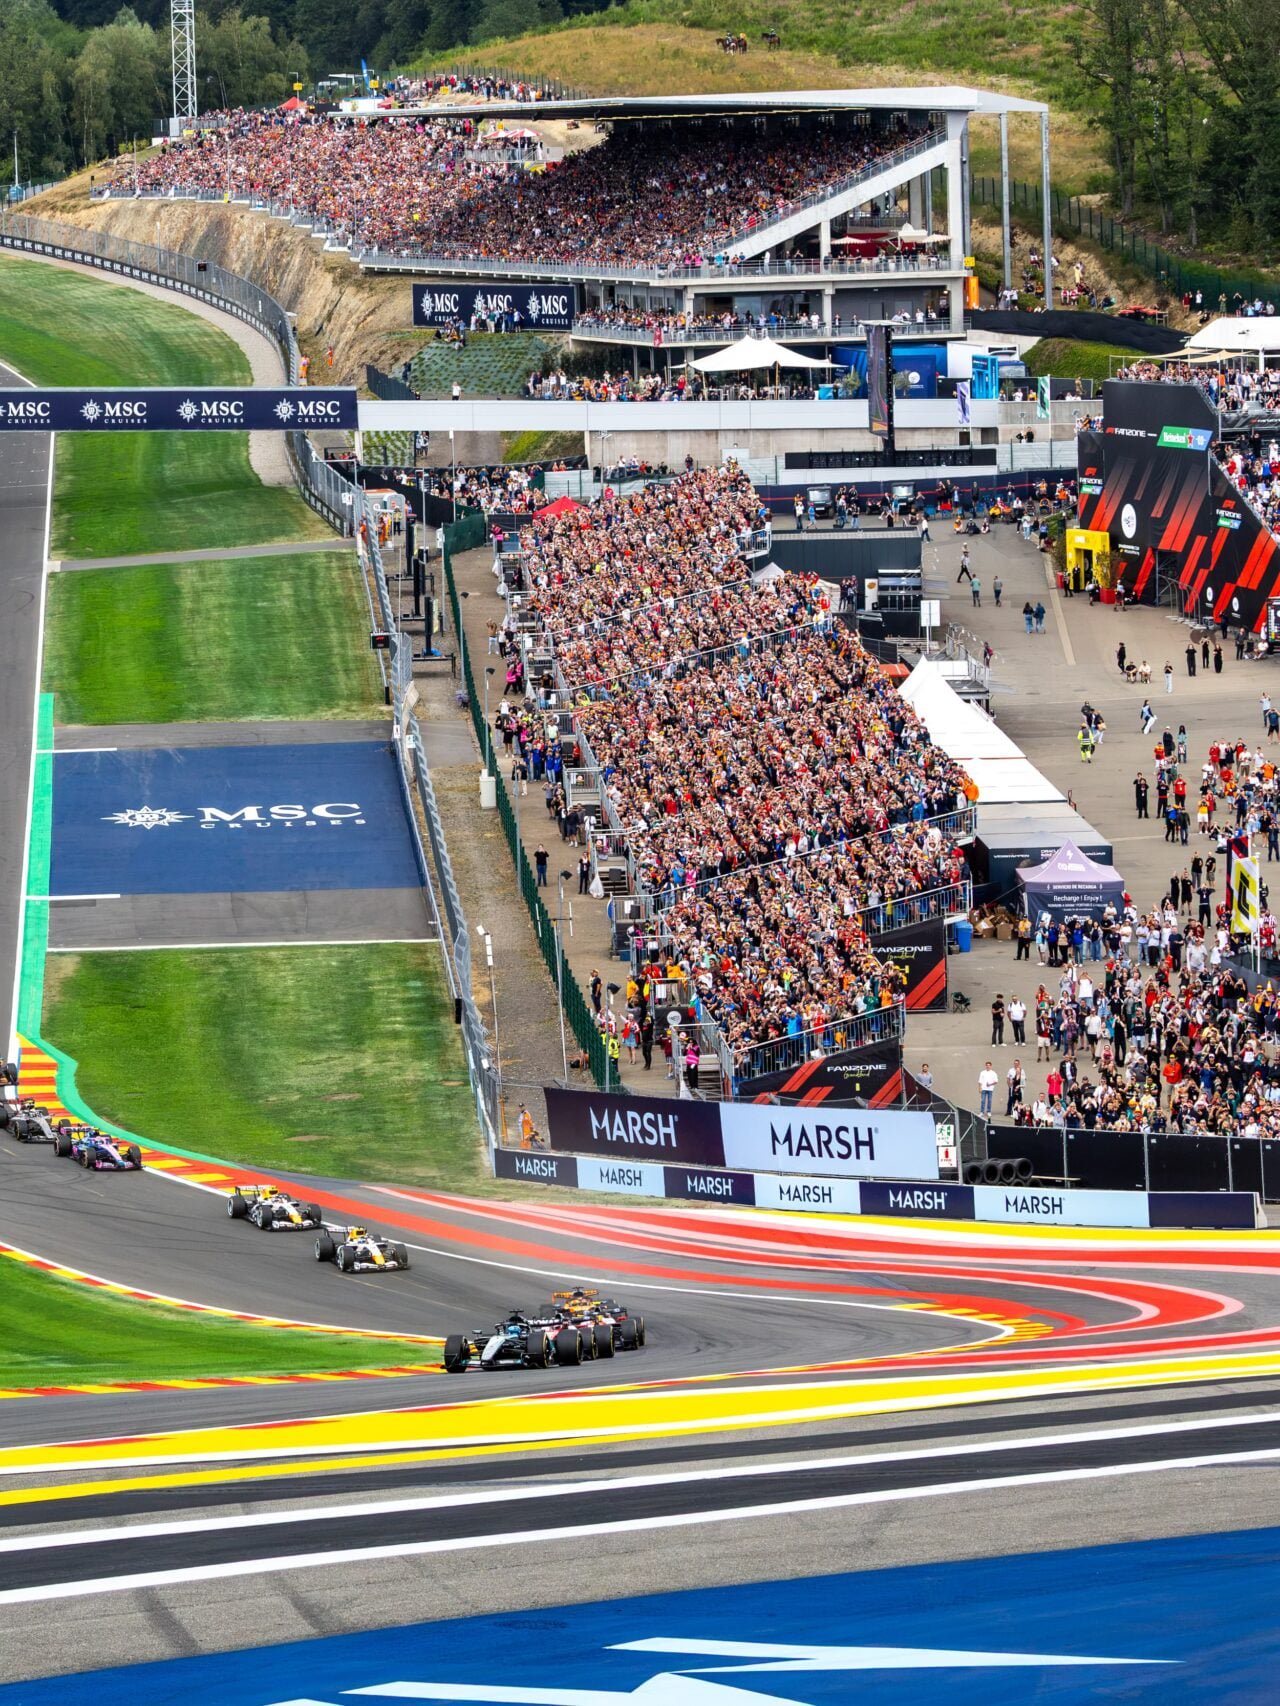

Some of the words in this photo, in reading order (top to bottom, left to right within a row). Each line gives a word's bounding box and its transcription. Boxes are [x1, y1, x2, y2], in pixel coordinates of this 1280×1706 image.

[434, 294, 459, 312] MSC
[486, 294, 512, 314] MSC
[541, 295, 568, 315] MSC
[8, 402, 50, 417] MSC
[104, 402, 147, 417] MSC
[201, 402, 244, 416] MSC
[298, 401, 340, 416] MSC
[1115, 429, 1146, 438] FANZONE
[197, 803, 362, 822] MSC
[200, 819, 366, 829] CRUISES
[827, 1064, 887, 1072] FANZONE
[589, 1106, 677, 1147] MARSH
[770, 1121, 874, 1160] MARSH
[515, 1157, 557, 1177] MARSH
[600, 1167, 642, 1187] MARSH
[687, 1175, 732, 1196] MARSH
[779, 1184, 832, 1203] MARSH
[889, 1190, 945, 1210] MARSH
[1005, 1195, 1063, 1214] MARSH
